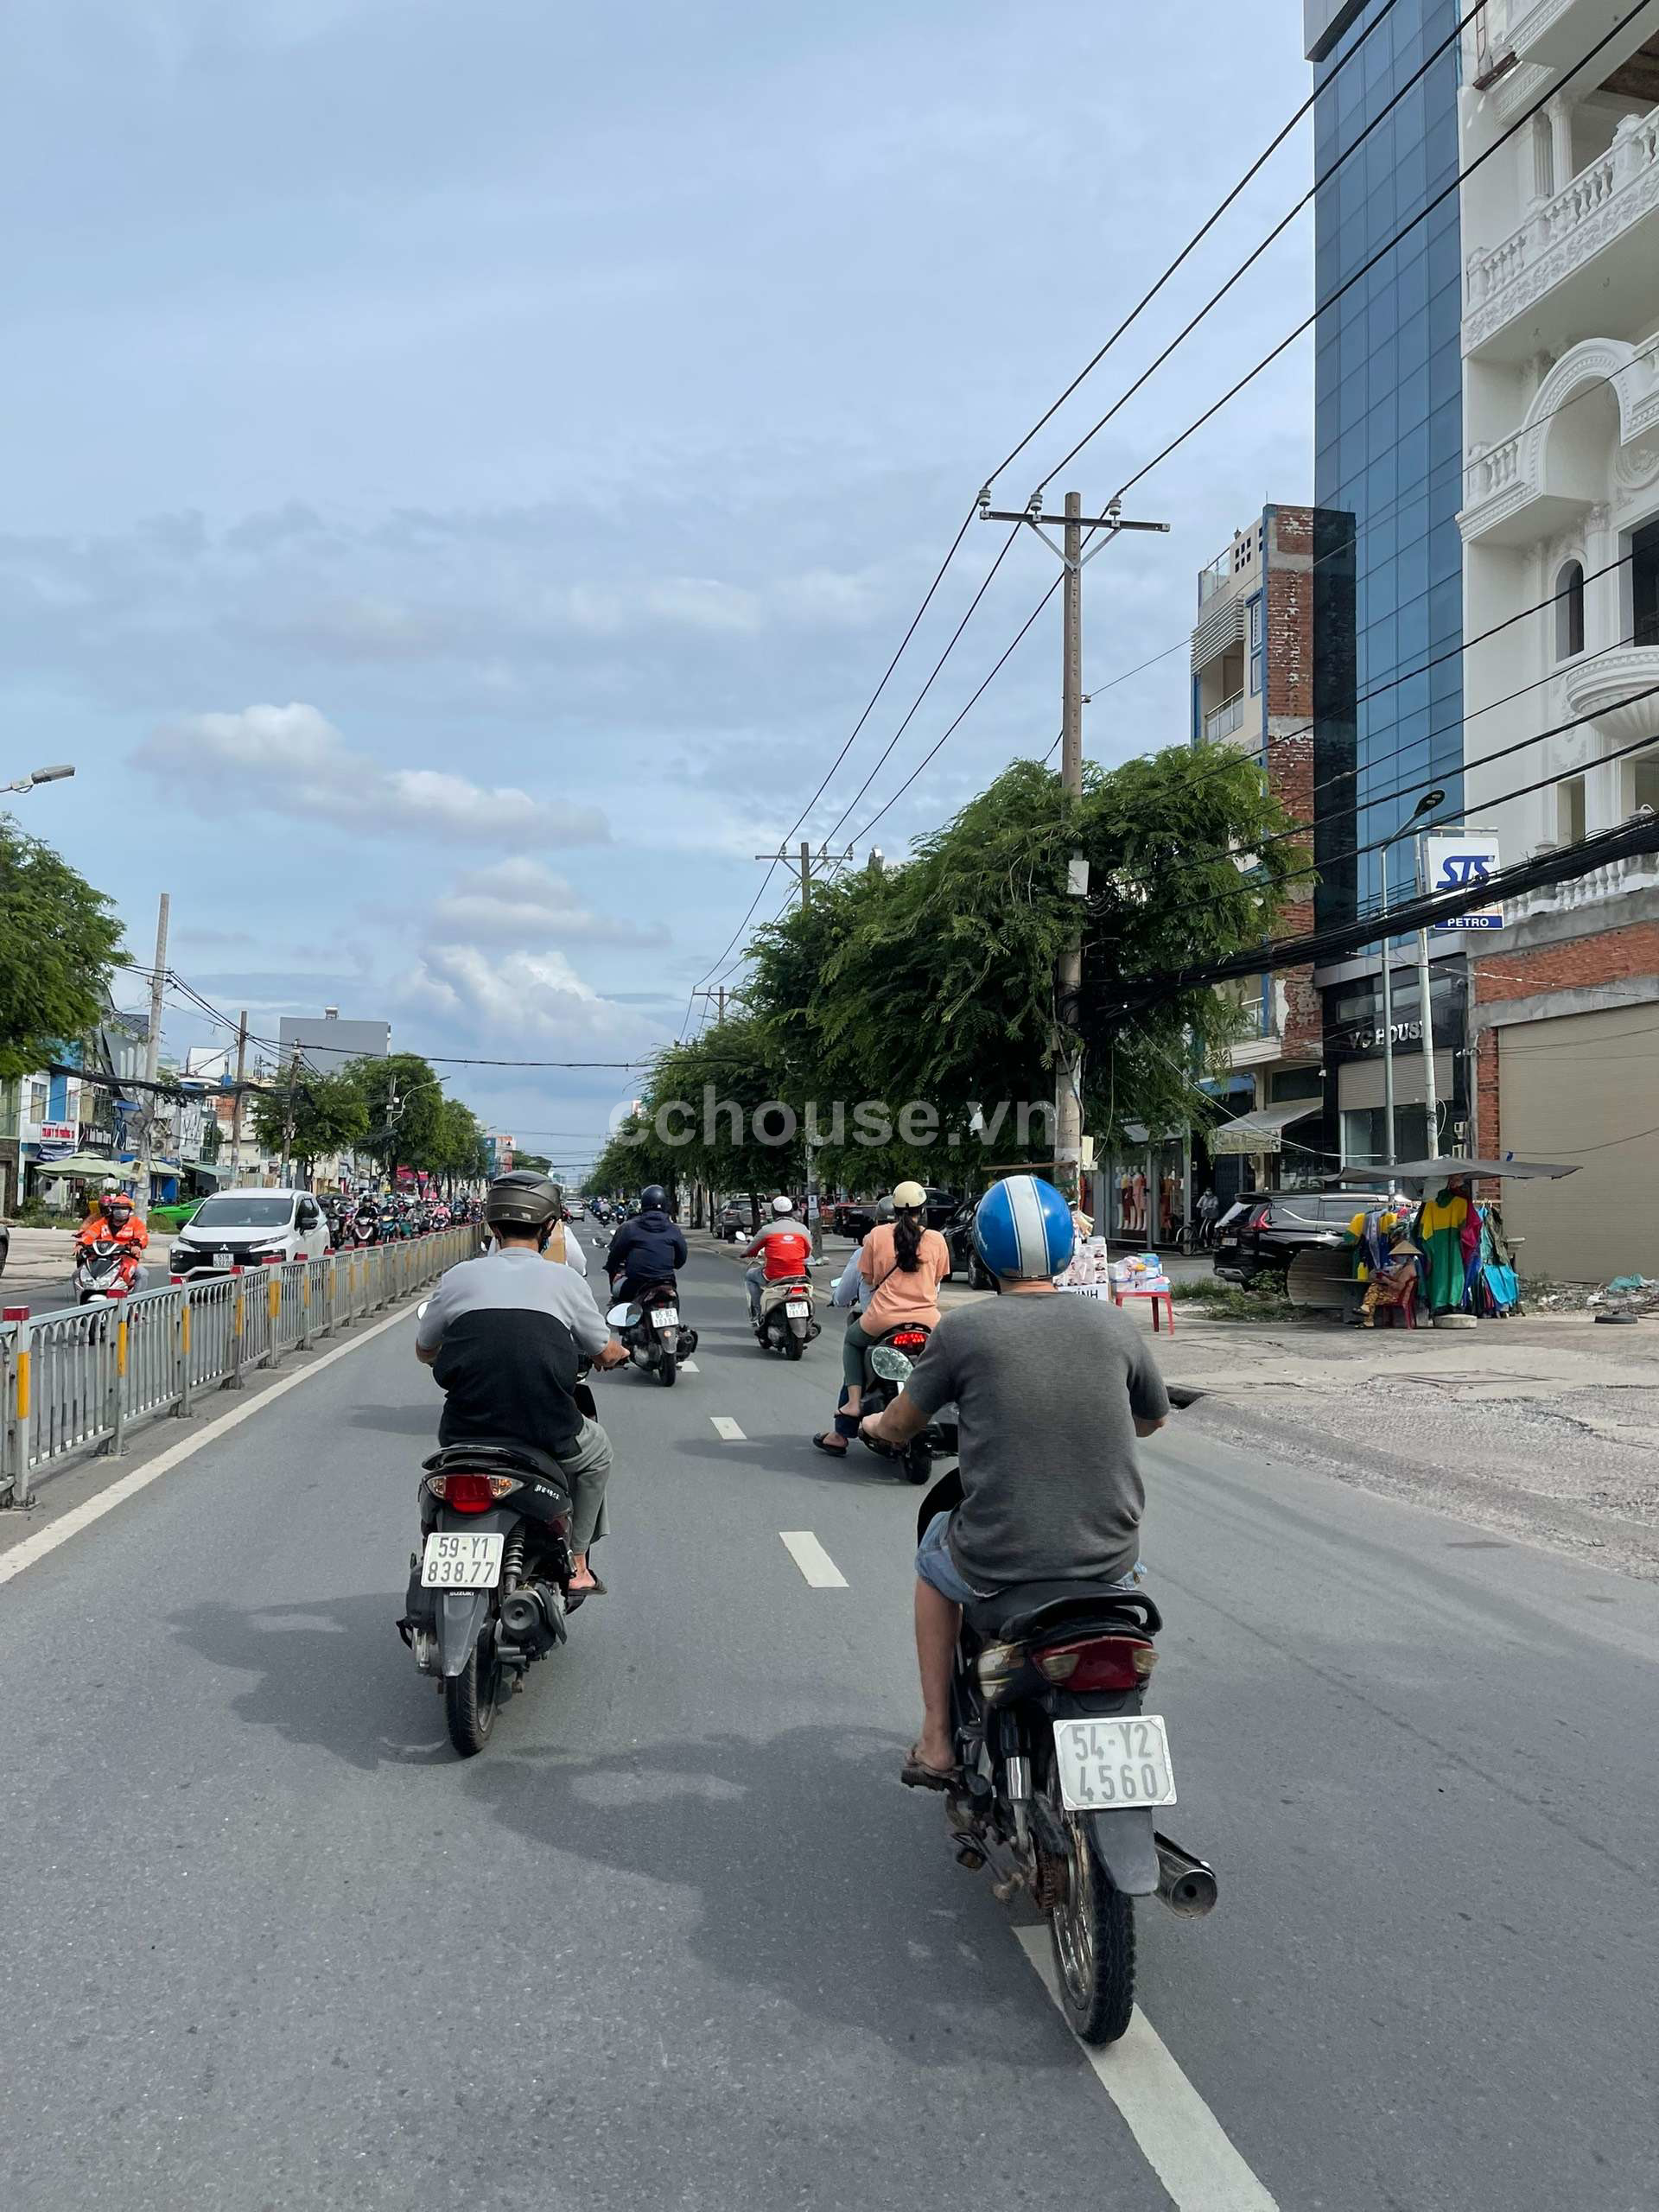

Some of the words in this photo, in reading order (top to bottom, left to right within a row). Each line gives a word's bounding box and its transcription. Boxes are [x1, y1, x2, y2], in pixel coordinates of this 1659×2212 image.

[1447, 918, 1490, 927] PETRO
[438, 1538, 489, 1559] 59-Y1
[428, 1561, 495, 1583] 838.77
[1071, 1724, 1153, 1761] 54-Y2
[1080, 1764, 1159, 1802] 4560
